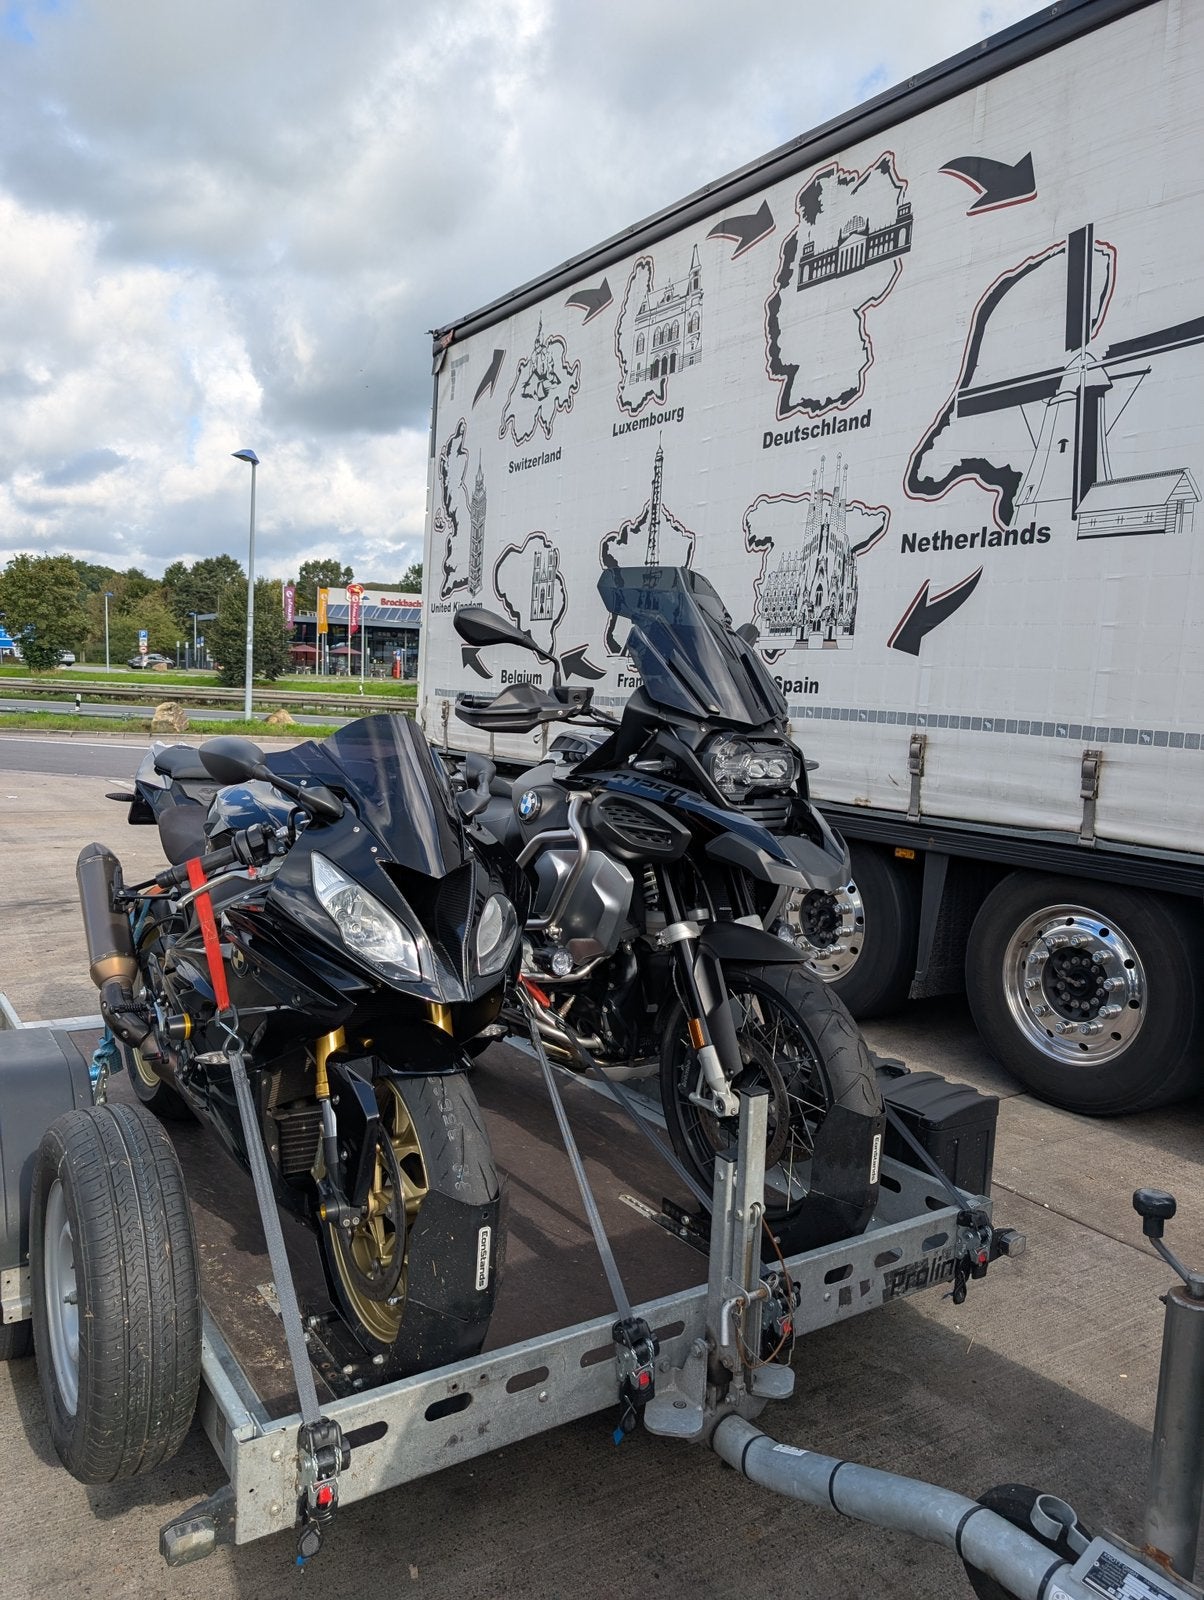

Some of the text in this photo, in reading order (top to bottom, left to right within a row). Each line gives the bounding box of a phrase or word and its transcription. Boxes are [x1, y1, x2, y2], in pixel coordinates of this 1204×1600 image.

[612, 406, 685, 437] Luxembourg
[762, 409, 872, 449] Deutschland
[508, 446, 562, 474] Switzerland
[900, 522, 1051, 554] Netherlands
[430, 602, 451, 613] United
[501, 669, 542, 684] Belgium
[617, 673, 643, 688] Fran
[773, 675, 819, 697] Spain
[890, 1255, 956, 1297] Prolin
